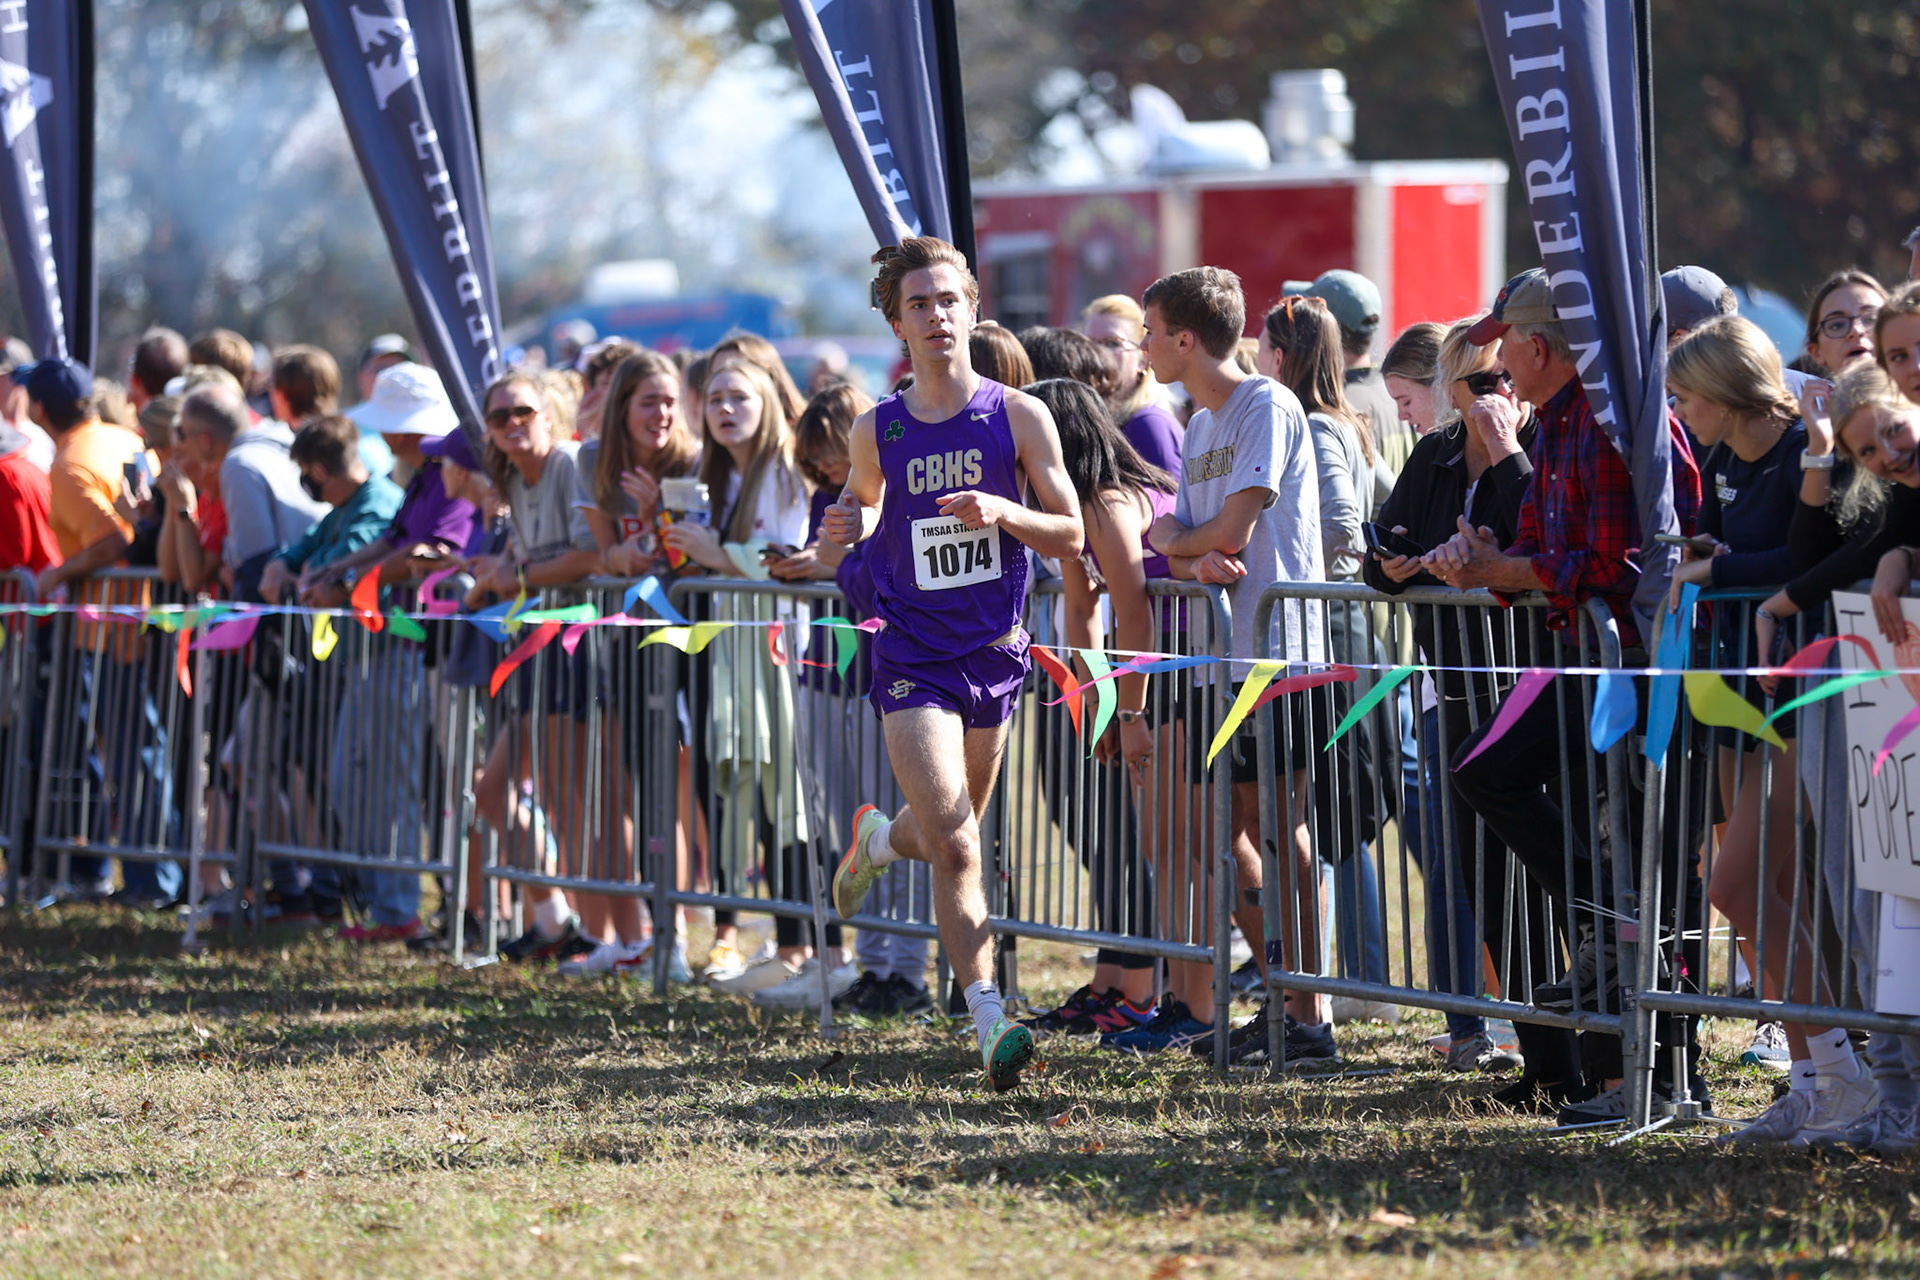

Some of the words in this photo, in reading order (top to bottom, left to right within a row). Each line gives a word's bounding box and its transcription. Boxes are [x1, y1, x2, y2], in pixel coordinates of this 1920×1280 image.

[1503, 0, 1624, 454] NDERBIL
[906, 448, 983, 496] CBHS
[923, 537, 993, 579] 1074
